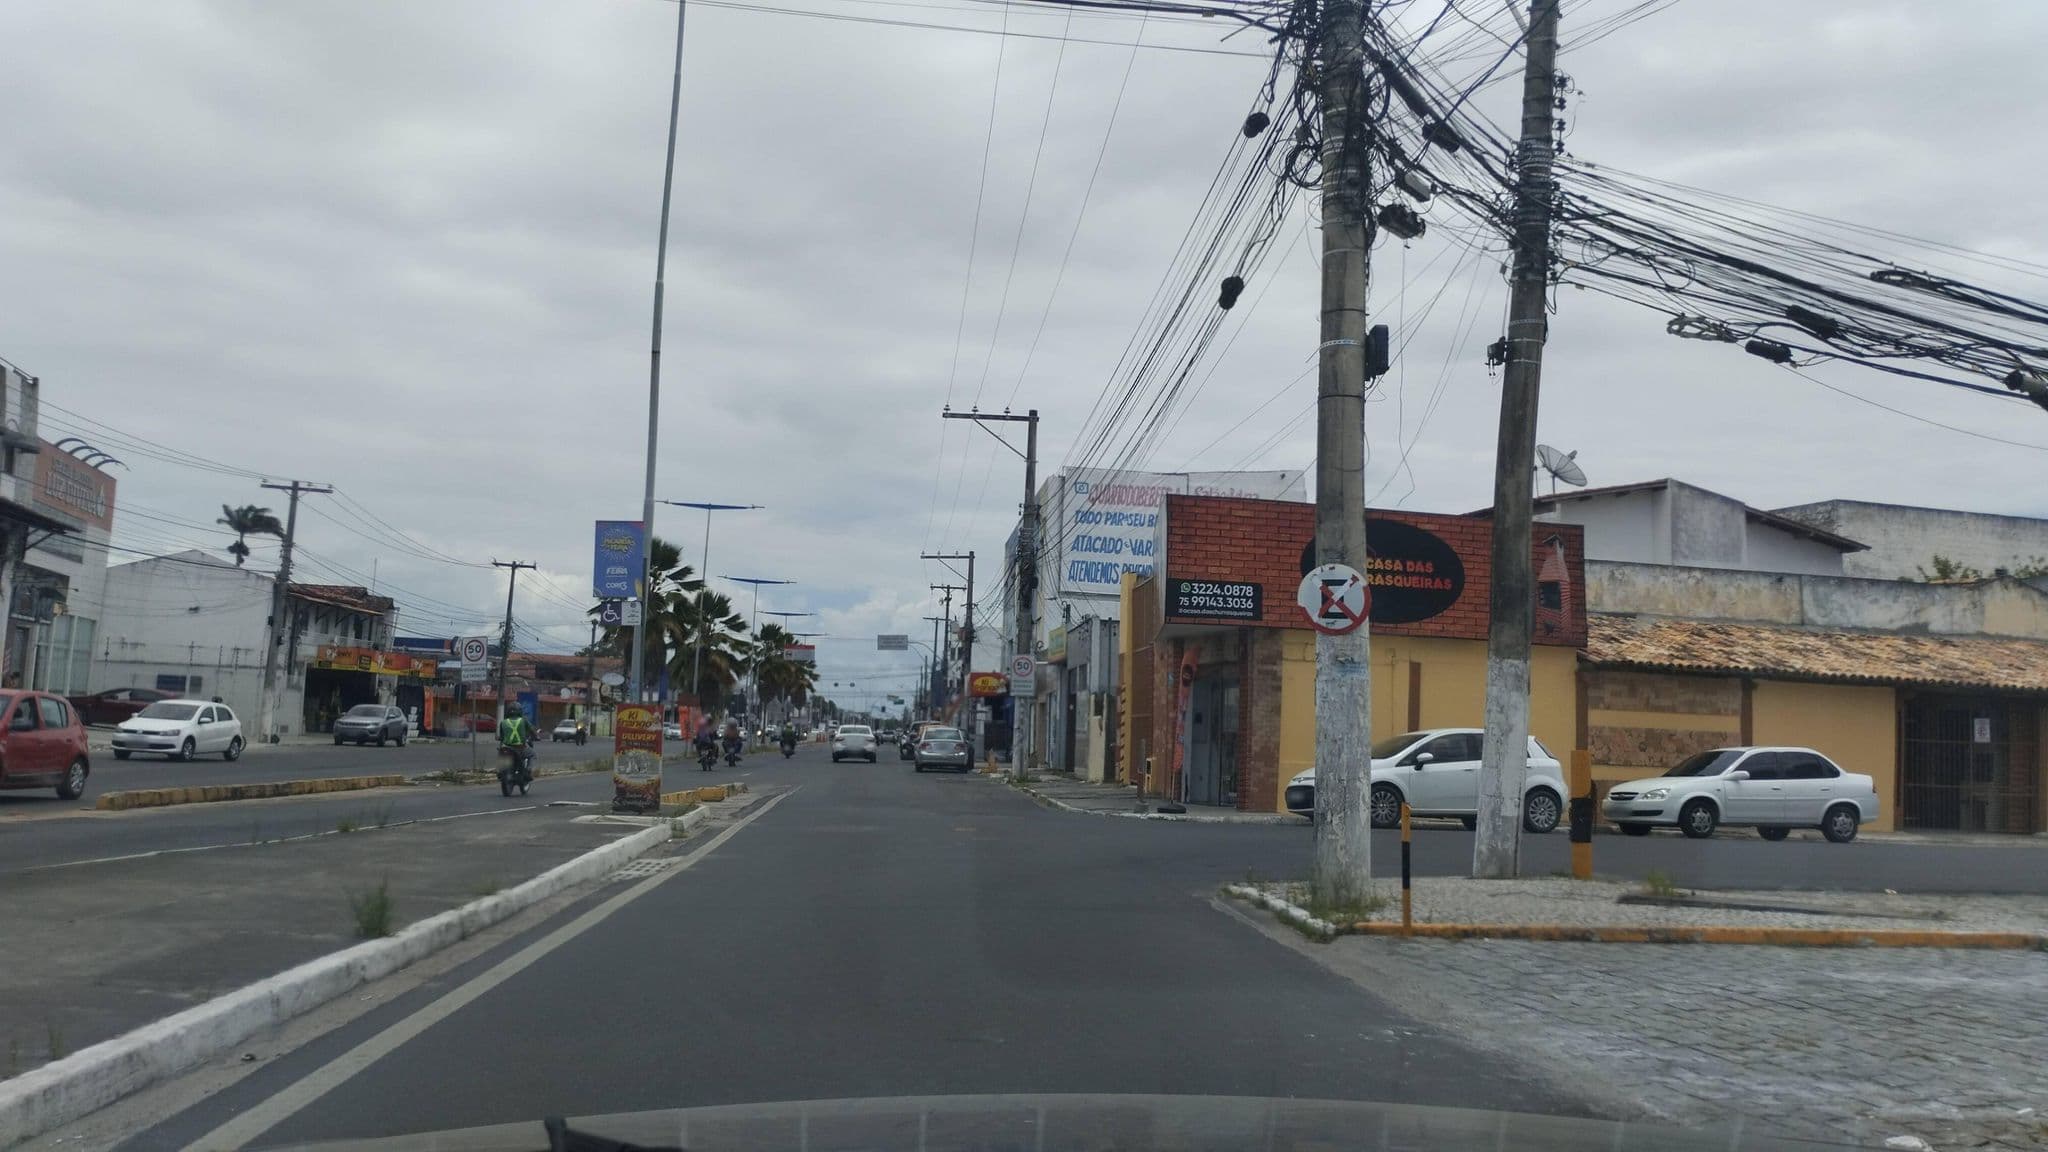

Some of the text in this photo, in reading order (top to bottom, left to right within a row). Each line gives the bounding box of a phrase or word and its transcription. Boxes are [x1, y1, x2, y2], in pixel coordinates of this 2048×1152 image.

[1071, 534, 1123, 555] ATACADO
[1129, 538, 1154, 557] VAR
[1068, 560, 1120, 585] ATENDEMOS
[1366, 558, 1434, 573] CASA DAS
[1191, 582, 1254, 597] 3224.0878
[1178, 596, 1254, 609] 75 99143.3036
[468, 644, 482, 654] 50
[1017, 661, 1030, 670] 50
[622, 732, 657, 741] DELIVERY
